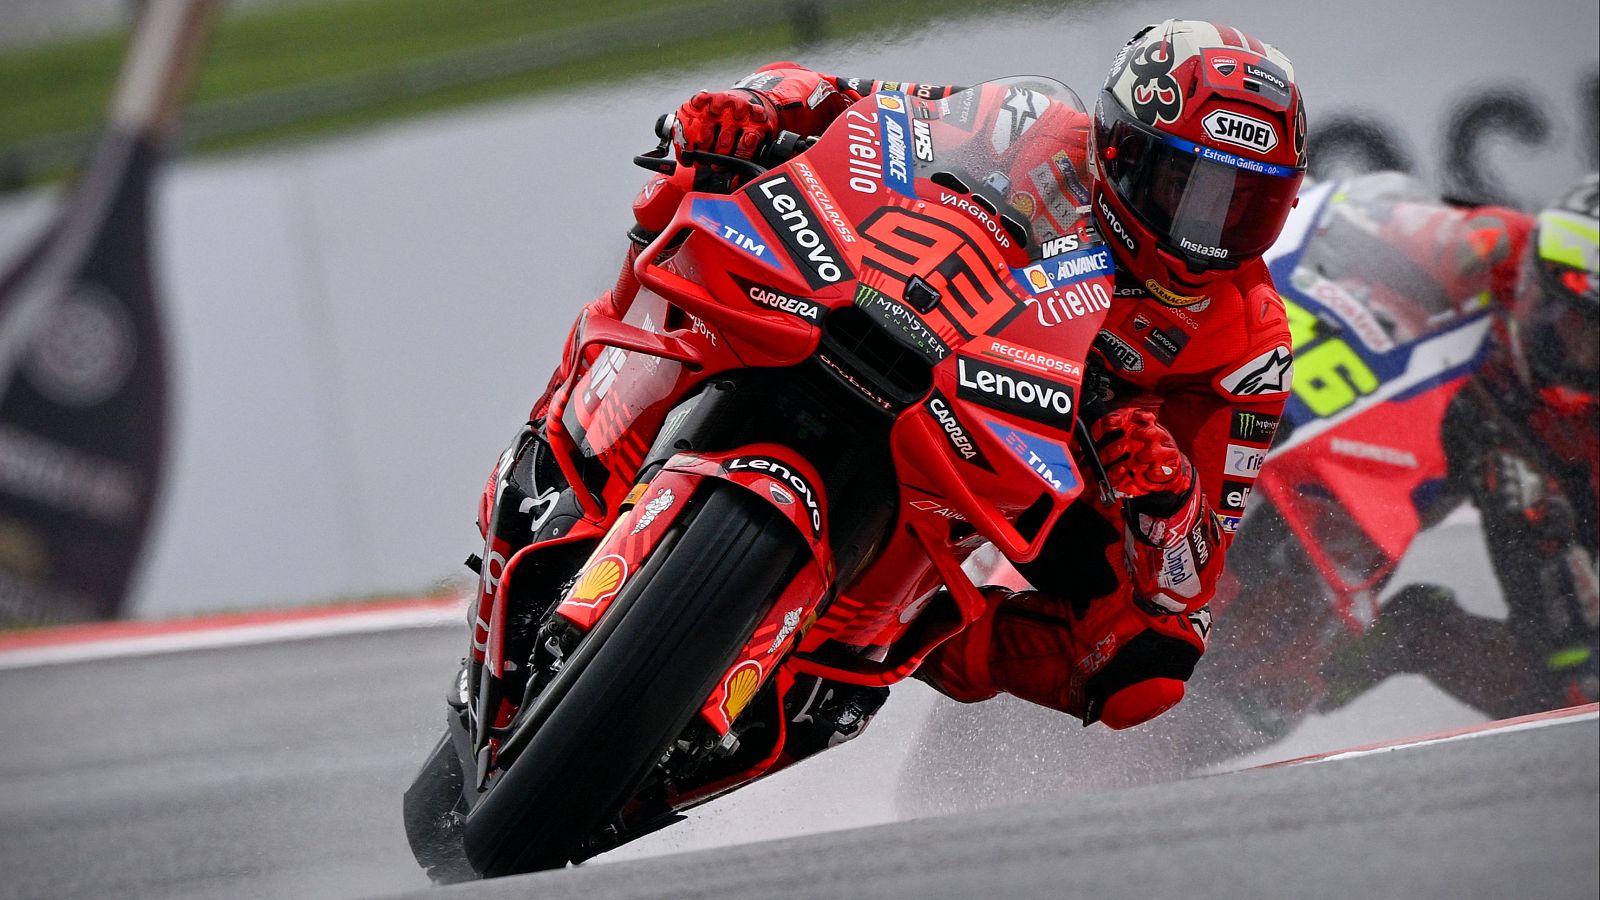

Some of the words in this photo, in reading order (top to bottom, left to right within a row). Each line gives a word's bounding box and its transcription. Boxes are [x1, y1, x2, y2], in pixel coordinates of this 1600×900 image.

[1247, 65, 1286, 88] Lenovo
[884, 115, 908, 184] ADVANCE
[1214, 116, 1271, 147] SHOEI
[847, 122, 882, 194] riello
[1203, 149, 1236, 165] Estrella
[1236, 157, 1263, 173] Galicia
[724, 225, 765, 257] TIM
[758, 176, 842, 283] Lenovo
[940, 192, 1010, 249] VARGROUP
[1098, 192, 1136, 250] Lenovo
[1057, 251, 1108, 281] ADVANCE
[1179, 237, 1228, 259] Insta360
[858, 206, 1024, 340] 93
[750, 286, 818, 319] CARRERA
[1047, 281, 1112, 324] riello
[876, 296, 945, 360] MONSTER
[1152, 329, 1178, 352] Lenovo
[991, 341, 1080, 377] RECCIAROSSA
[958, 359, 1072, 415] Lenovo
[930, 398, 977, 460] CARRERA
[1028, 450, 1062, 490] TIM
[729, 458, 820, 531] Lenovo
[1164, 543, 1193, 586] Unipol
